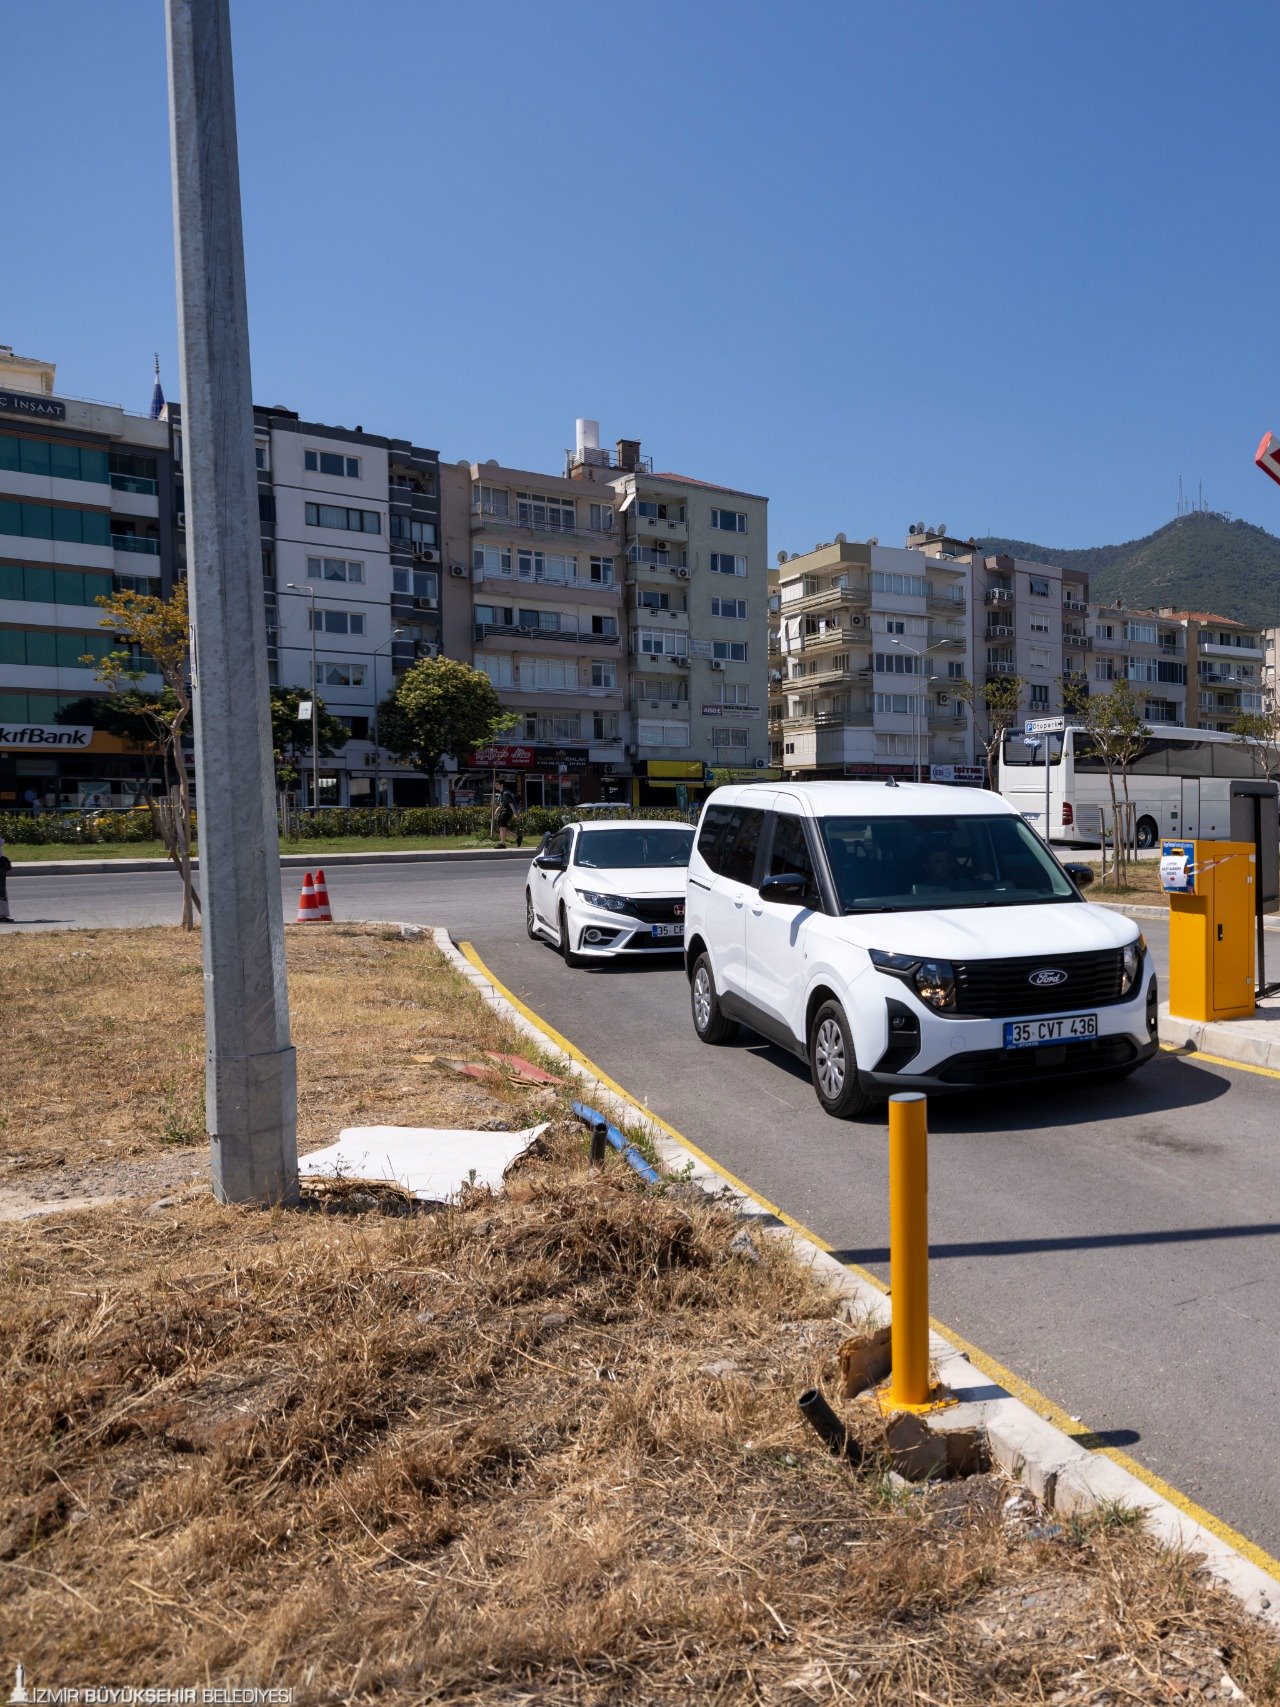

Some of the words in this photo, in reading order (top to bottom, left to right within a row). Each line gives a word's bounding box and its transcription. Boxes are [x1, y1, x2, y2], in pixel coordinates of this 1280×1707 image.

[14, 397, 62, 415] İNŞAAT
[1033, 719, 1058, 731] Otopark
[0, 727, 87, 745] kıfBank
[658, 926, 669, 936] 35
[1036, 971, 1060, 984] Ford
[1013, 1024, 1031, 1042] 35
[1038, 1020, 1064, 1039] CVT
[1070, 1017, 1095, 1035] 436
